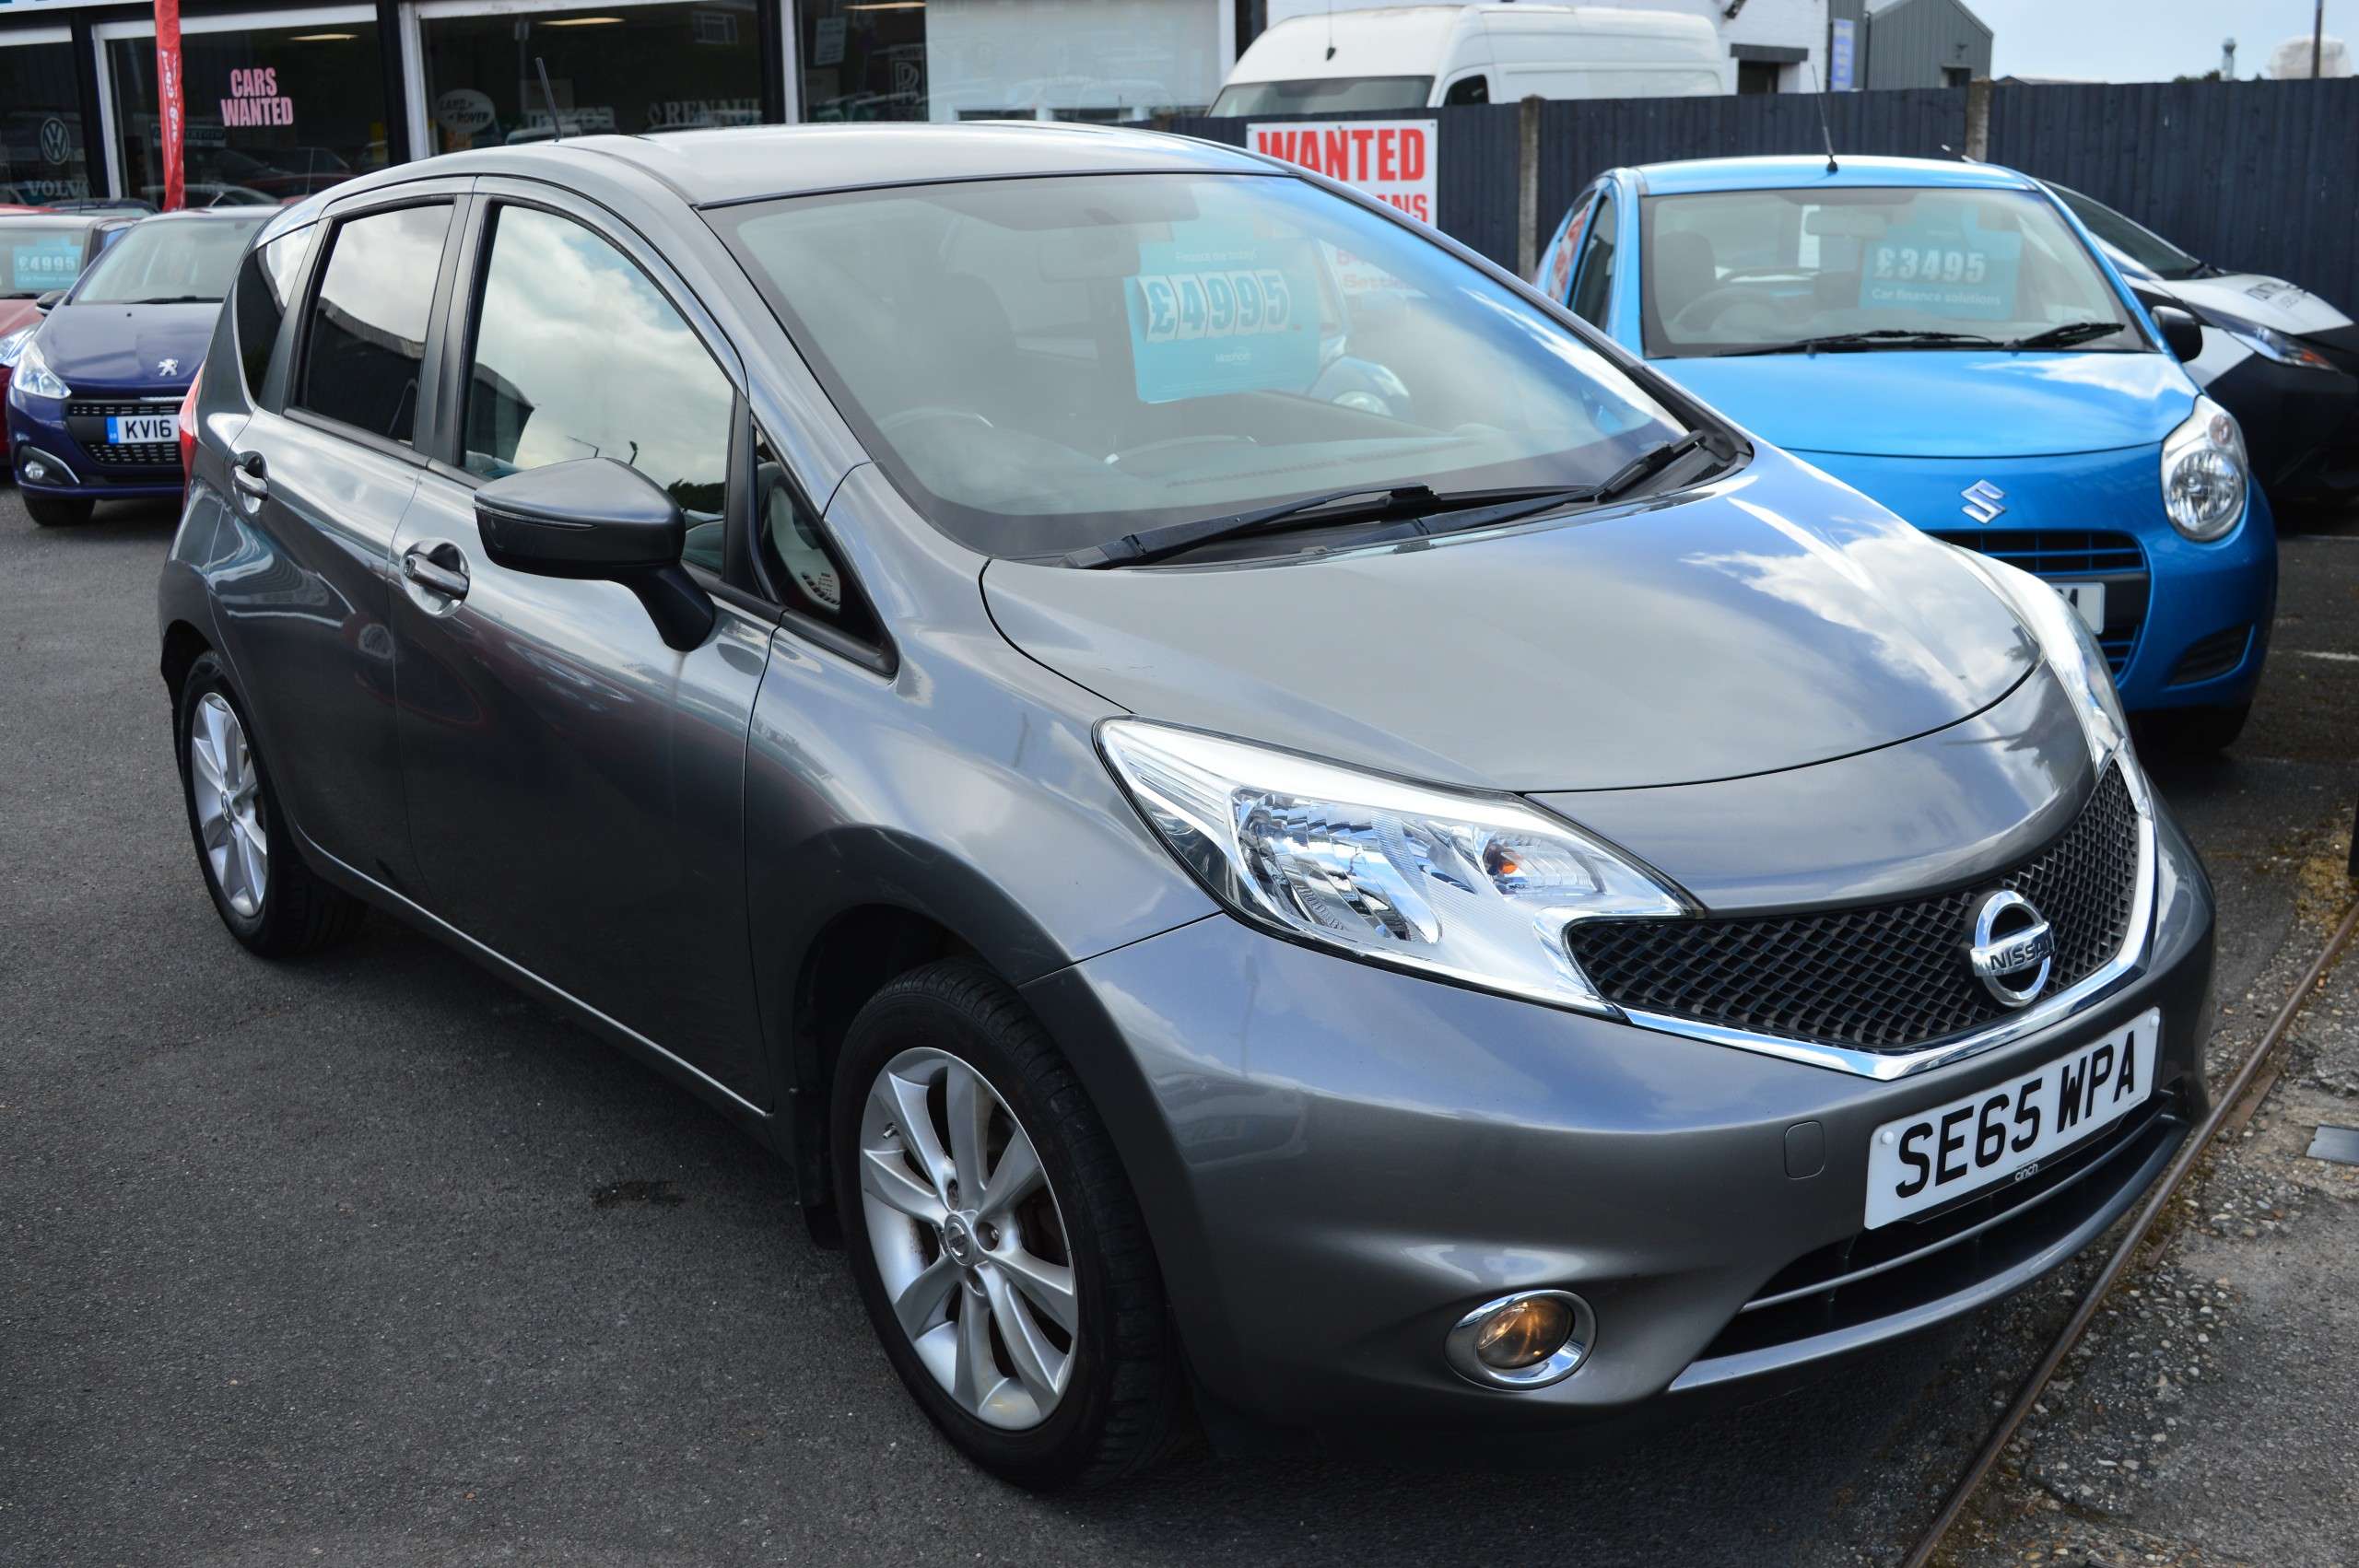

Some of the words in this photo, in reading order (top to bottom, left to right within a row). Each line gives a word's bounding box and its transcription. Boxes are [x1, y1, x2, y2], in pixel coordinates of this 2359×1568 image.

[230, 67, 278, 98] CARS
[220, 96, 294, 127] WANTED
[1873, 247, 1987, 284] £3495
[1146, 275, 1289, 334] £4995
[1872, 288, 1895, 300] Car
[1895, 290, 1942, 302] finance
[1944, 293, 2001, 306] solutions
[124, 419, 172, 439] KV16
[1895, 1077, 2043, 1199] SE65
[2056, 1031, 2136, 1135] WPA
